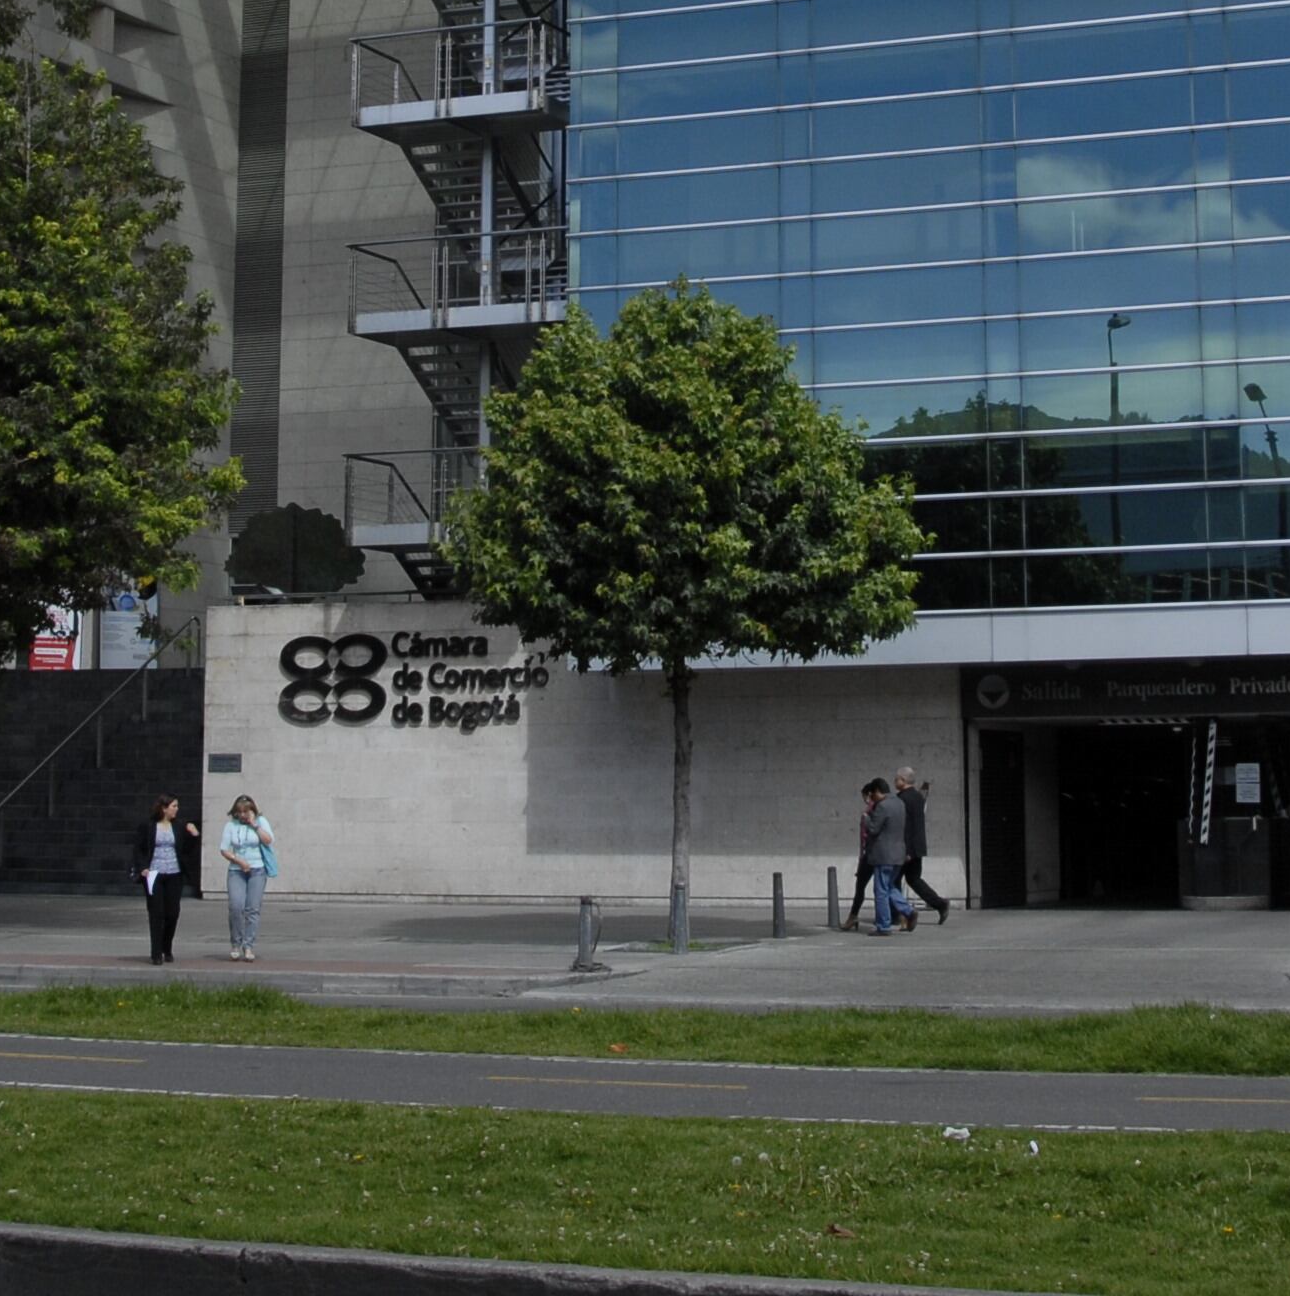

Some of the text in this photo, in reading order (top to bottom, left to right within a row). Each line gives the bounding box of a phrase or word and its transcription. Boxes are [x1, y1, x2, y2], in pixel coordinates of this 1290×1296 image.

[391, 631, 488, 659] Cámara
[392, 658, 549, 693] de Comercio
[1020, 680, 1081, 700] Salida
[1106, 677, 1216, 702] Parqueadero
[392, 694, 521, 734] de Bogotá
